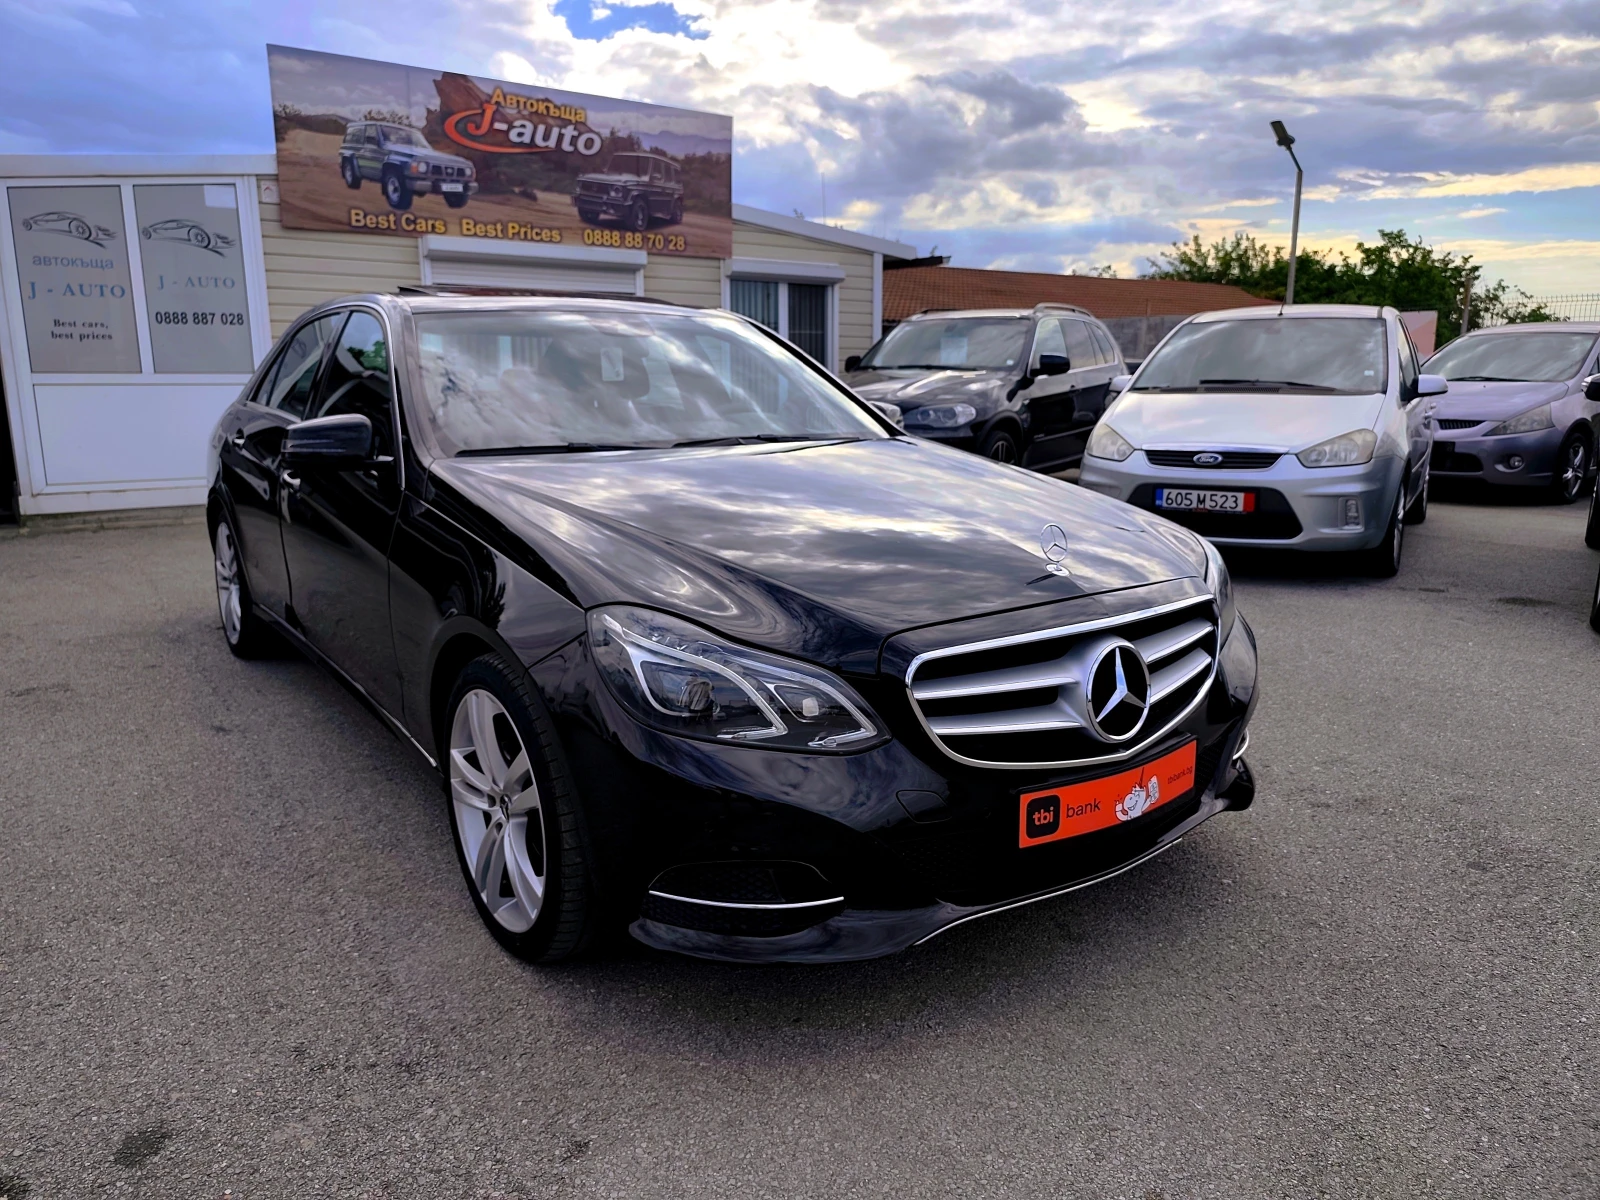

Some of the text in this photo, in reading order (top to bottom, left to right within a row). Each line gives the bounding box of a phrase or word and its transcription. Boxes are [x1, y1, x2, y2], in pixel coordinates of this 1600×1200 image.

[490, 87, 587, 123] Автокъща
[350, 209, 446, 234] Best Cars
[461, 218, 561, 243] Best Prices
[584, 228, 685, 251] 0888 88 70 28
[32, 255, 114, 271] автокъща
[28, 281, 36, 300] J
[62, 282, 126, 299] AUTO
[185, 276, 236, 290] AUTO
[53, 319, 77, 328] Best
[155, 311, 244, 326] 0888 887 028
[51, 330, 113, 342] best prices
[1032, 798, 1101, 826] tbi bank
